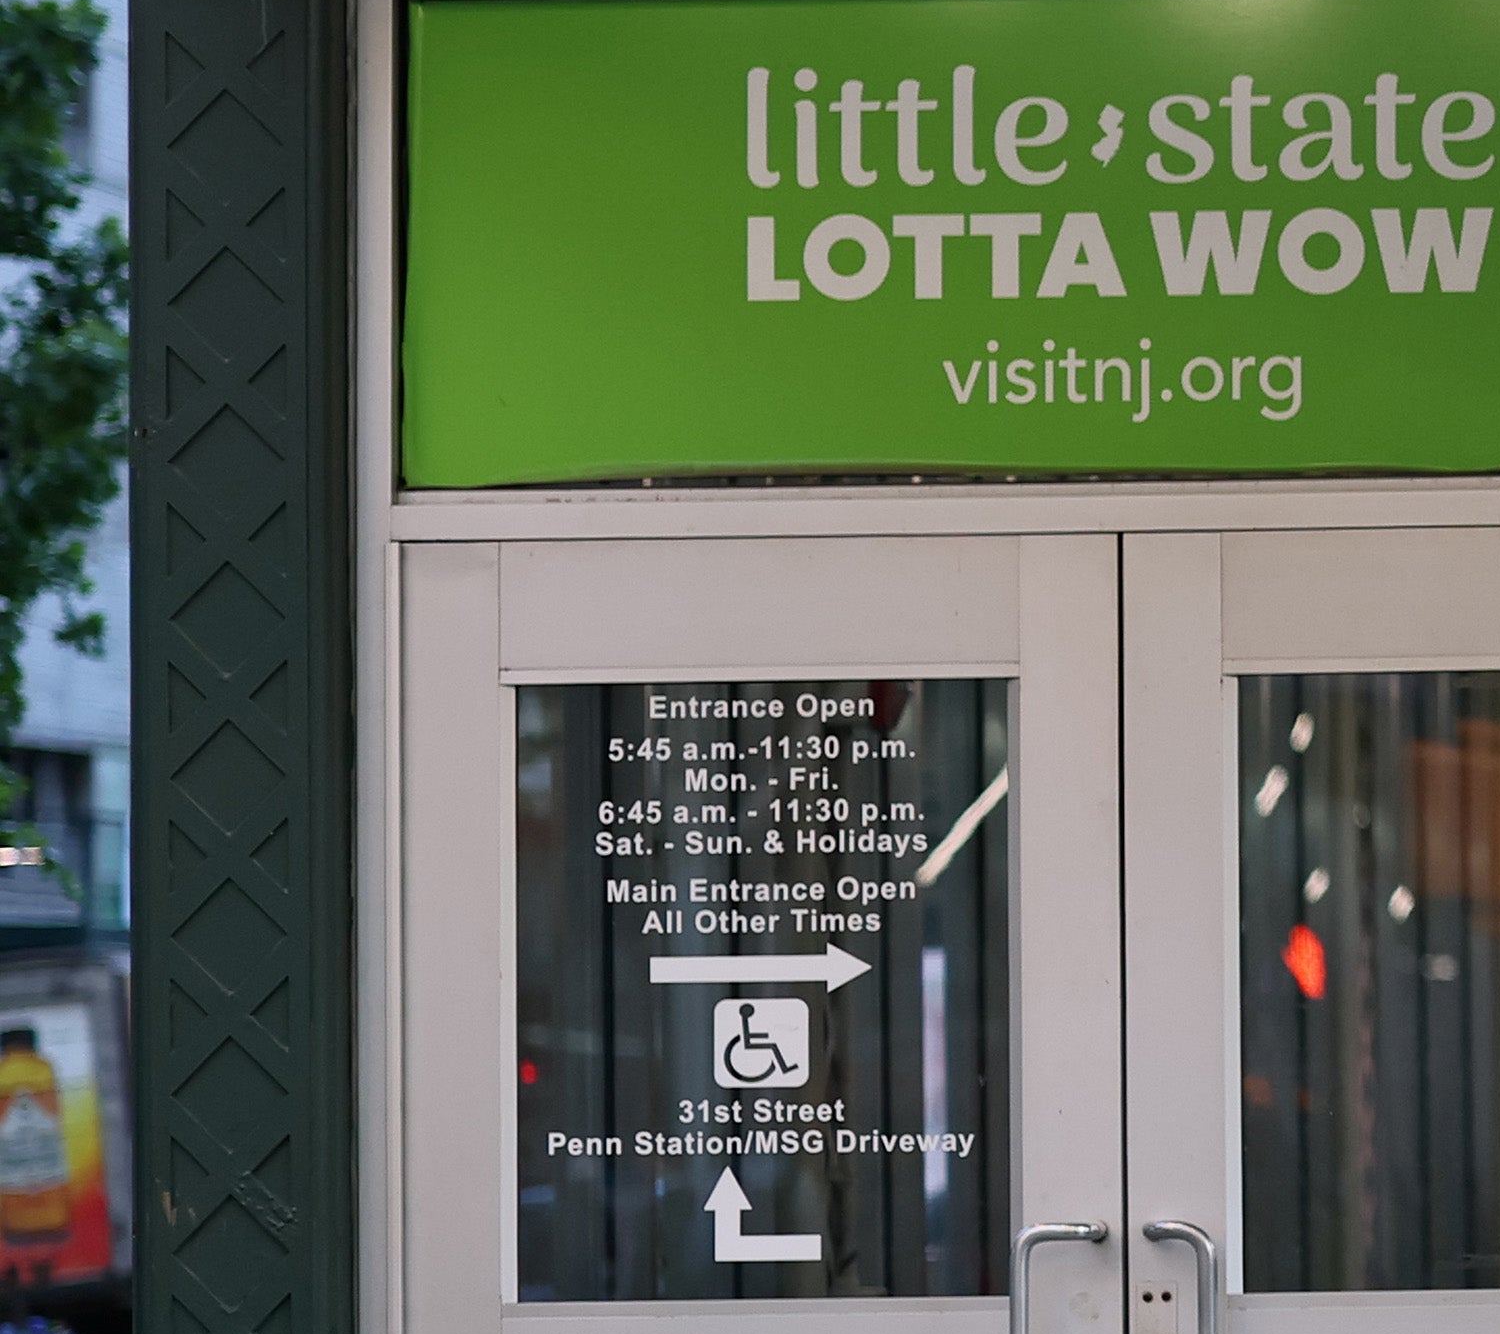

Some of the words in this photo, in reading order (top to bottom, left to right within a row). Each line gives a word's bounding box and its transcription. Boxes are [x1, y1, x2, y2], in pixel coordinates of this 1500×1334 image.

[745, 66, 1069, 189] little
[1145, 76, 1498, 185] state
[746, 212, 1128, 302] LOTTA
[1148, 207, 1495, 297] WOW
[941, 339, 1305, 423] visitnj.org
[649, 695, 784, 719] Entrance
[796, 693, 874, 723] Open
[608, 737, 672, 762] 5:45
[682, 735, 840, 761] a.m.-11:30
[852, 739, 916, 764] p.m.
[685, 768, 757, 792] Mon.
[789, 766, 838, 791] Fri.
[598, 800, 662, 825] 6:45
[673, 805, 736, 824] a.m.
[769, 798, 849, 822] 11:30
[861, 802, 925, 827] p.m.
[595, 831, 653, 856] Sat.
[685, 830, 752, 855] Sun.
[763, 829, 784, 854] &
[796, 828, 928, 858] Holidays
[607, 878, 677, 903] Main
[689, 878, 825, 902] Entrance
[837, 876, 916, 906] Open
[641, 910, 683, 934] All
[694, 909, 780, 934] Other
[790, 908, 881, 933] Times
[678, 1099, 743, 1124] 31st
[753, 1098, 845, 1123] Street
[548, 1132, 622, 1156] Penn
[634, 1129, 824, 1156] Station/MSG
[836, 1129, 975, 1158] Driveway
